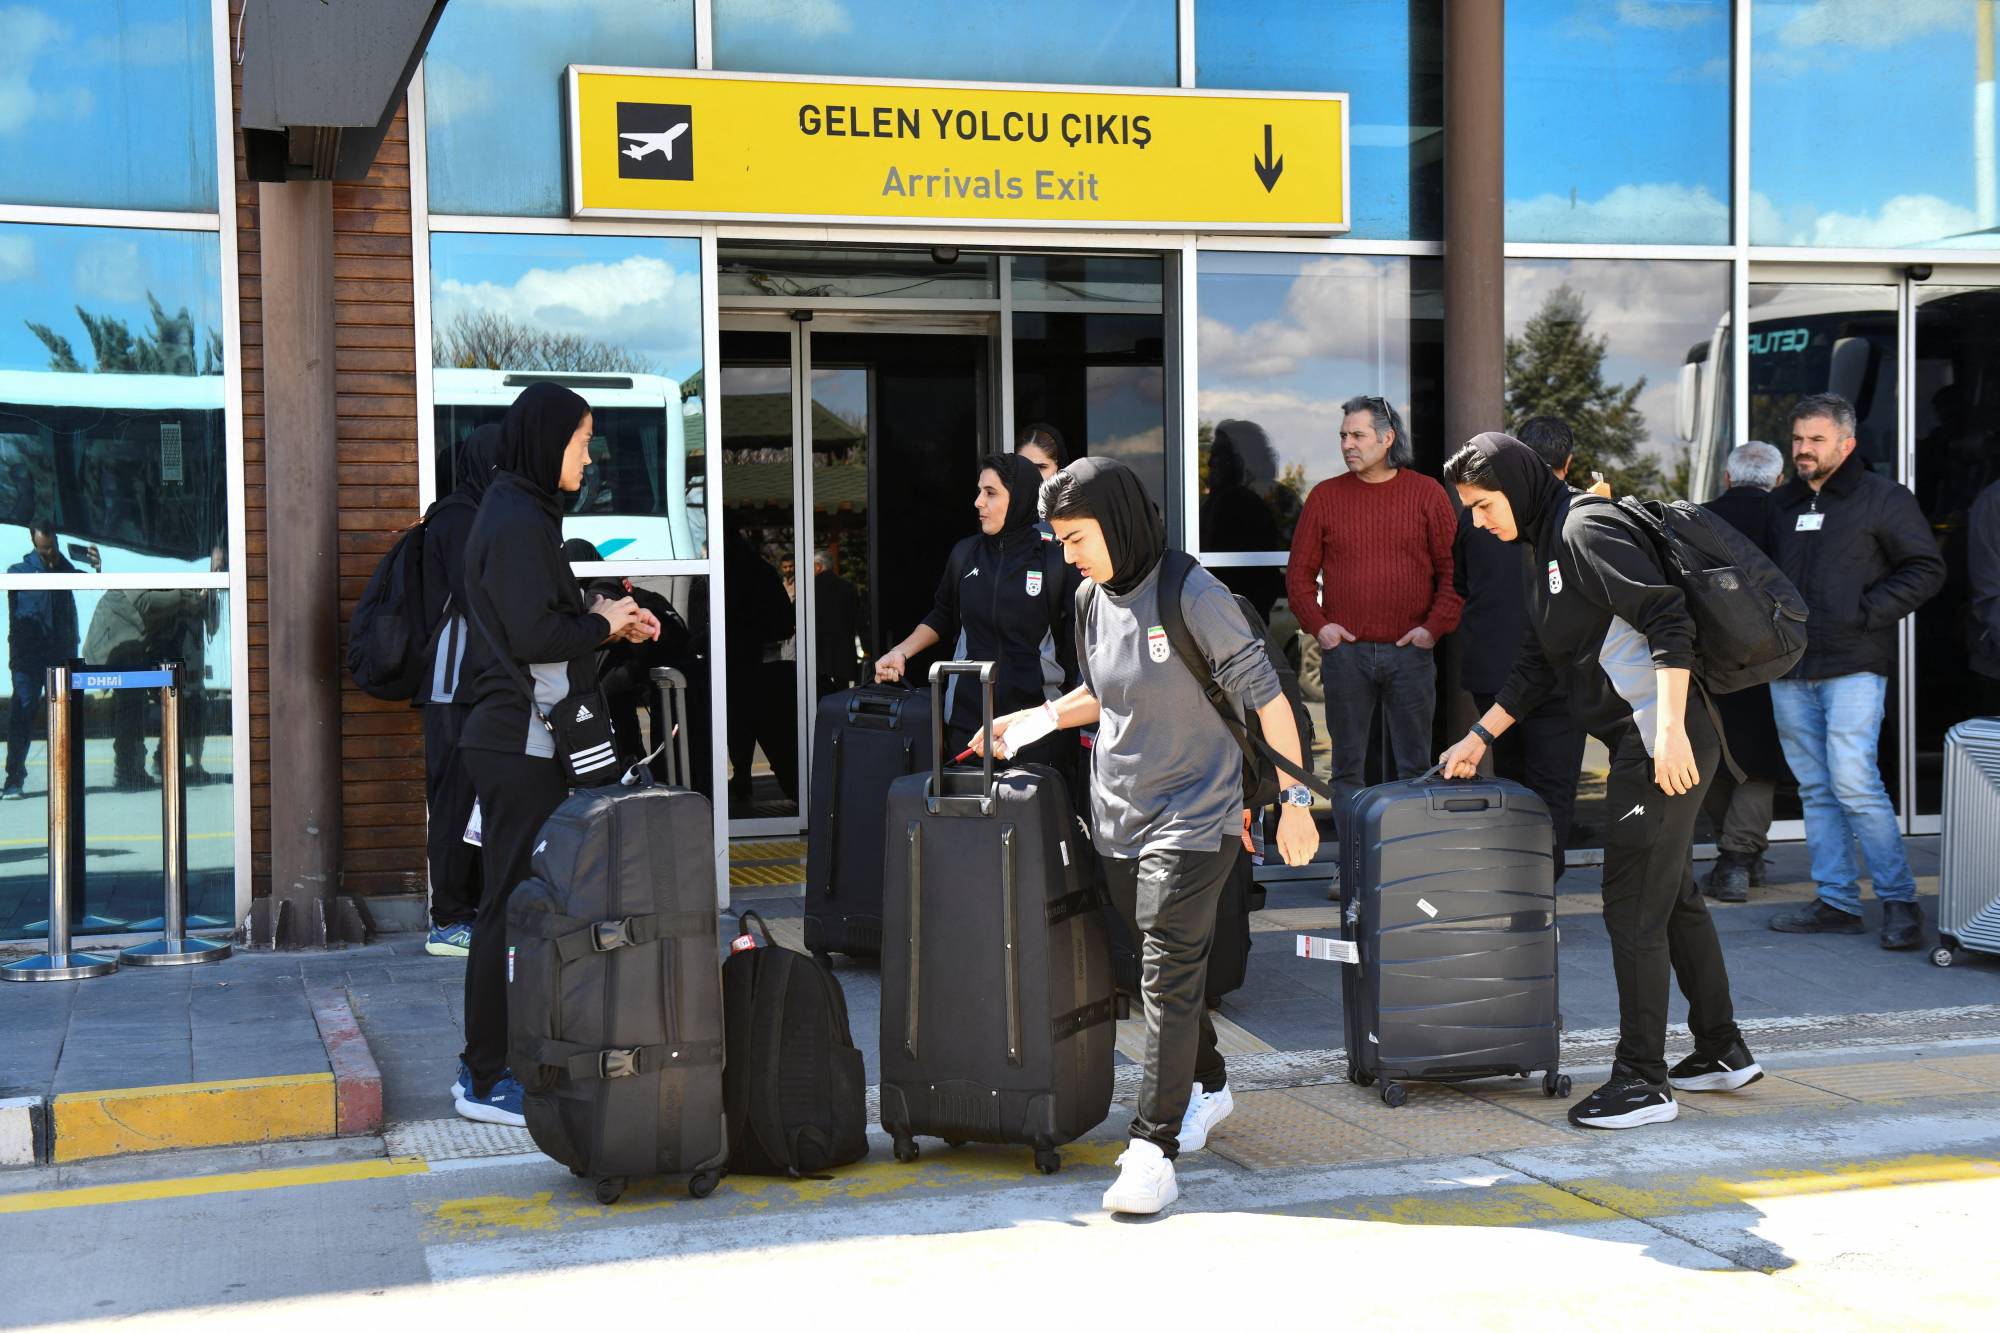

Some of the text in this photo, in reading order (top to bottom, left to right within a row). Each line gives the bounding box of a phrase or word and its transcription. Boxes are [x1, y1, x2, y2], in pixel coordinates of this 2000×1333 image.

[799, 104, 1152, 149] GELEN YOLCU ÇIKIŞ
[881, 165, 1099, 201] Arrivals Exit
